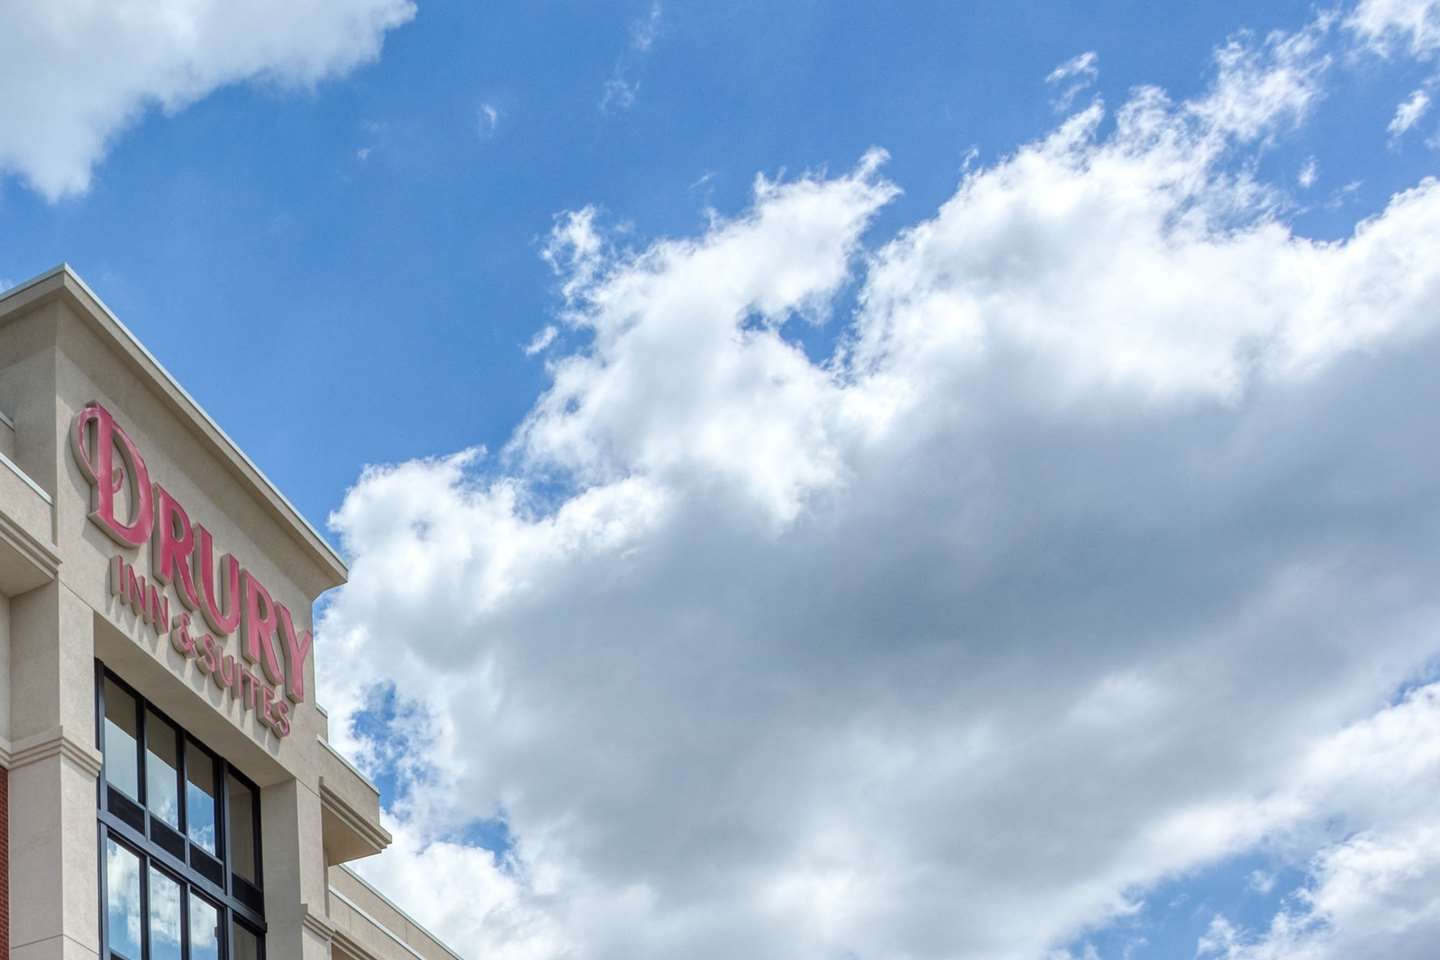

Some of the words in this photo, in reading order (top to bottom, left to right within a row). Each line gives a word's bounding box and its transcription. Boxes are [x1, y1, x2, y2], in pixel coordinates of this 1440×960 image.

[70, 401, 312, 704] DRURY
[110, 555, 169, 635] INN
[171, 611, 195, 658] &
[194, 632, 289, 738] SUITES
